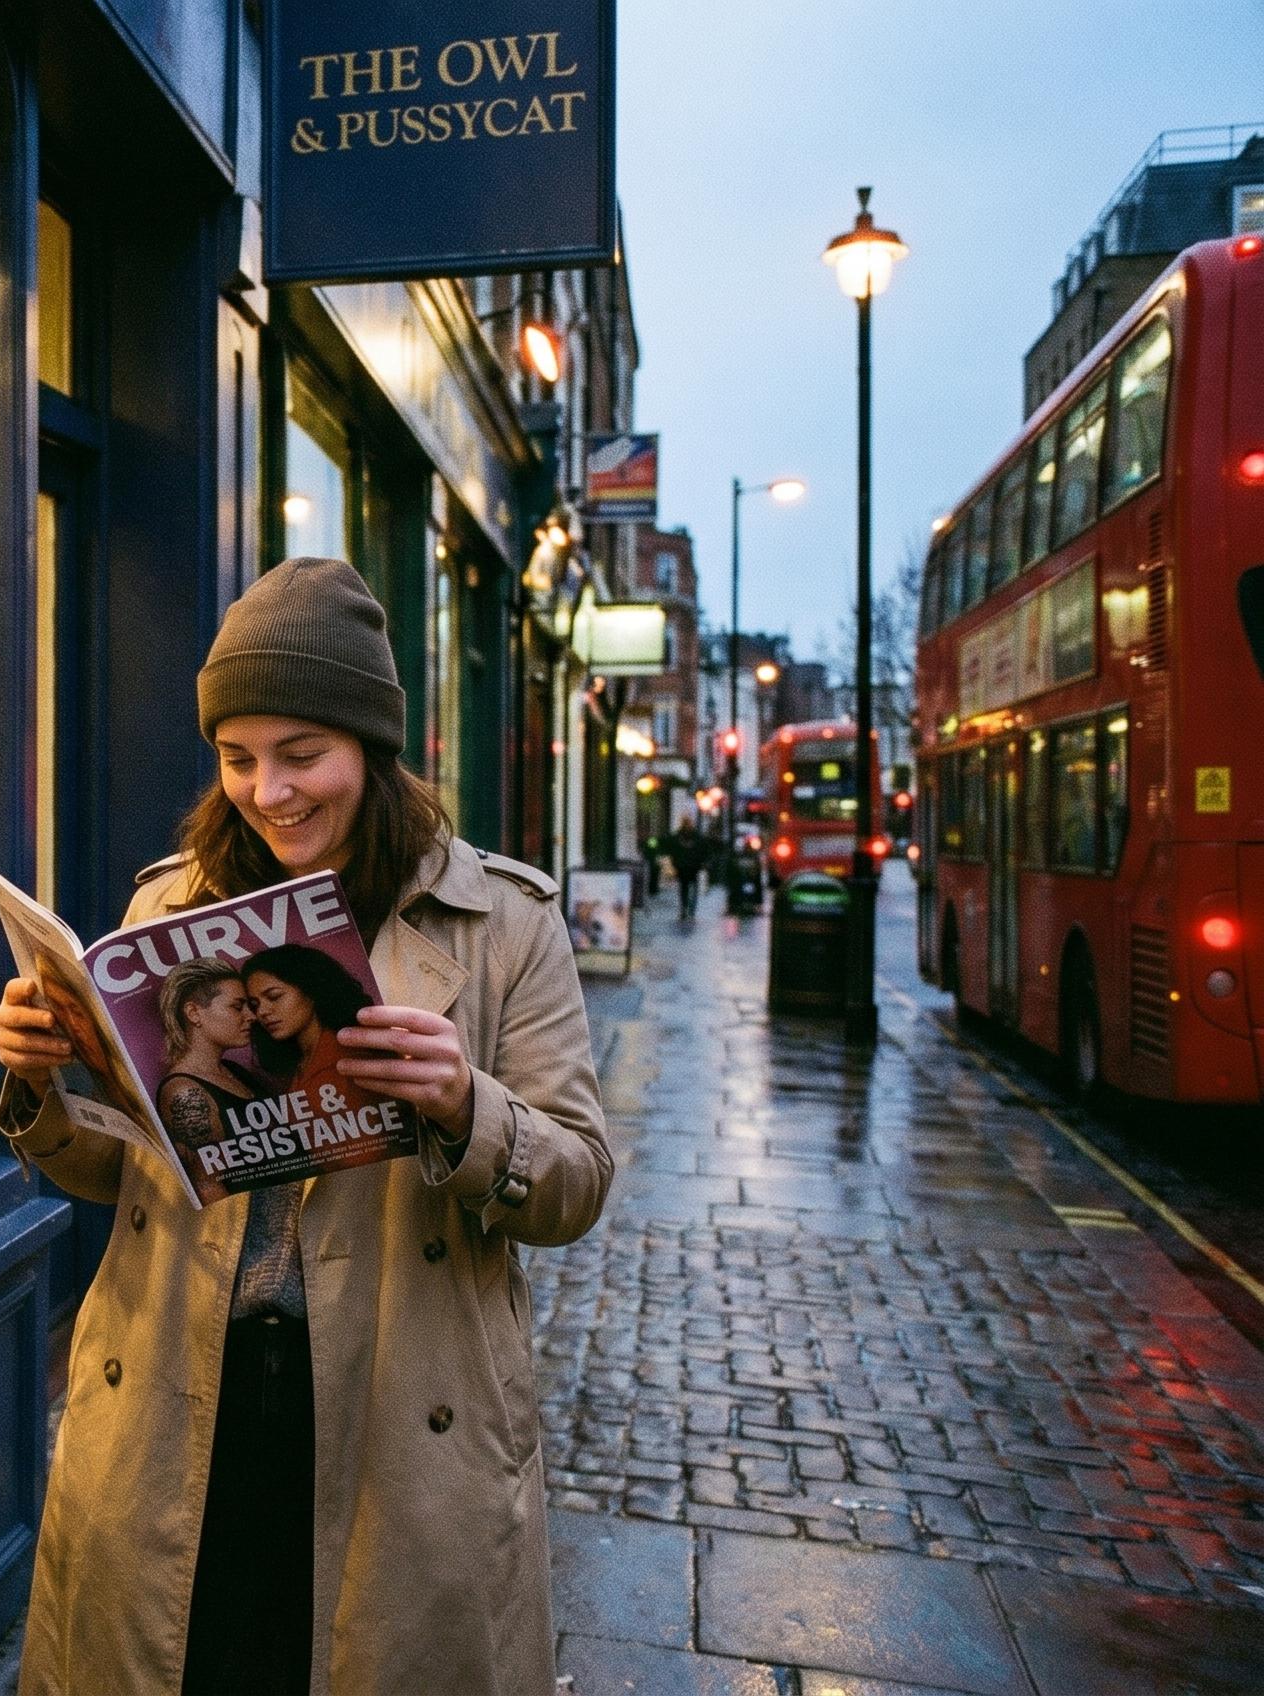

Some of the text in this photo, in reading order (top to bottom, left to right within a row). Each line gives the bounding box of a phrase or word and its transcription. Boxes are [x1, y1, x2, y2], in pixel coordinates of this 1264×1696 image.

[299, 31, 578, 100] THE OWL
[290, 91, 586, 154] & PUSSYCAT
[92, 880, 350, 996] CURVE
[197, 1101, 404, 1176] RESISTANCE
[226, 1083, 348, 1136] LOVE &
